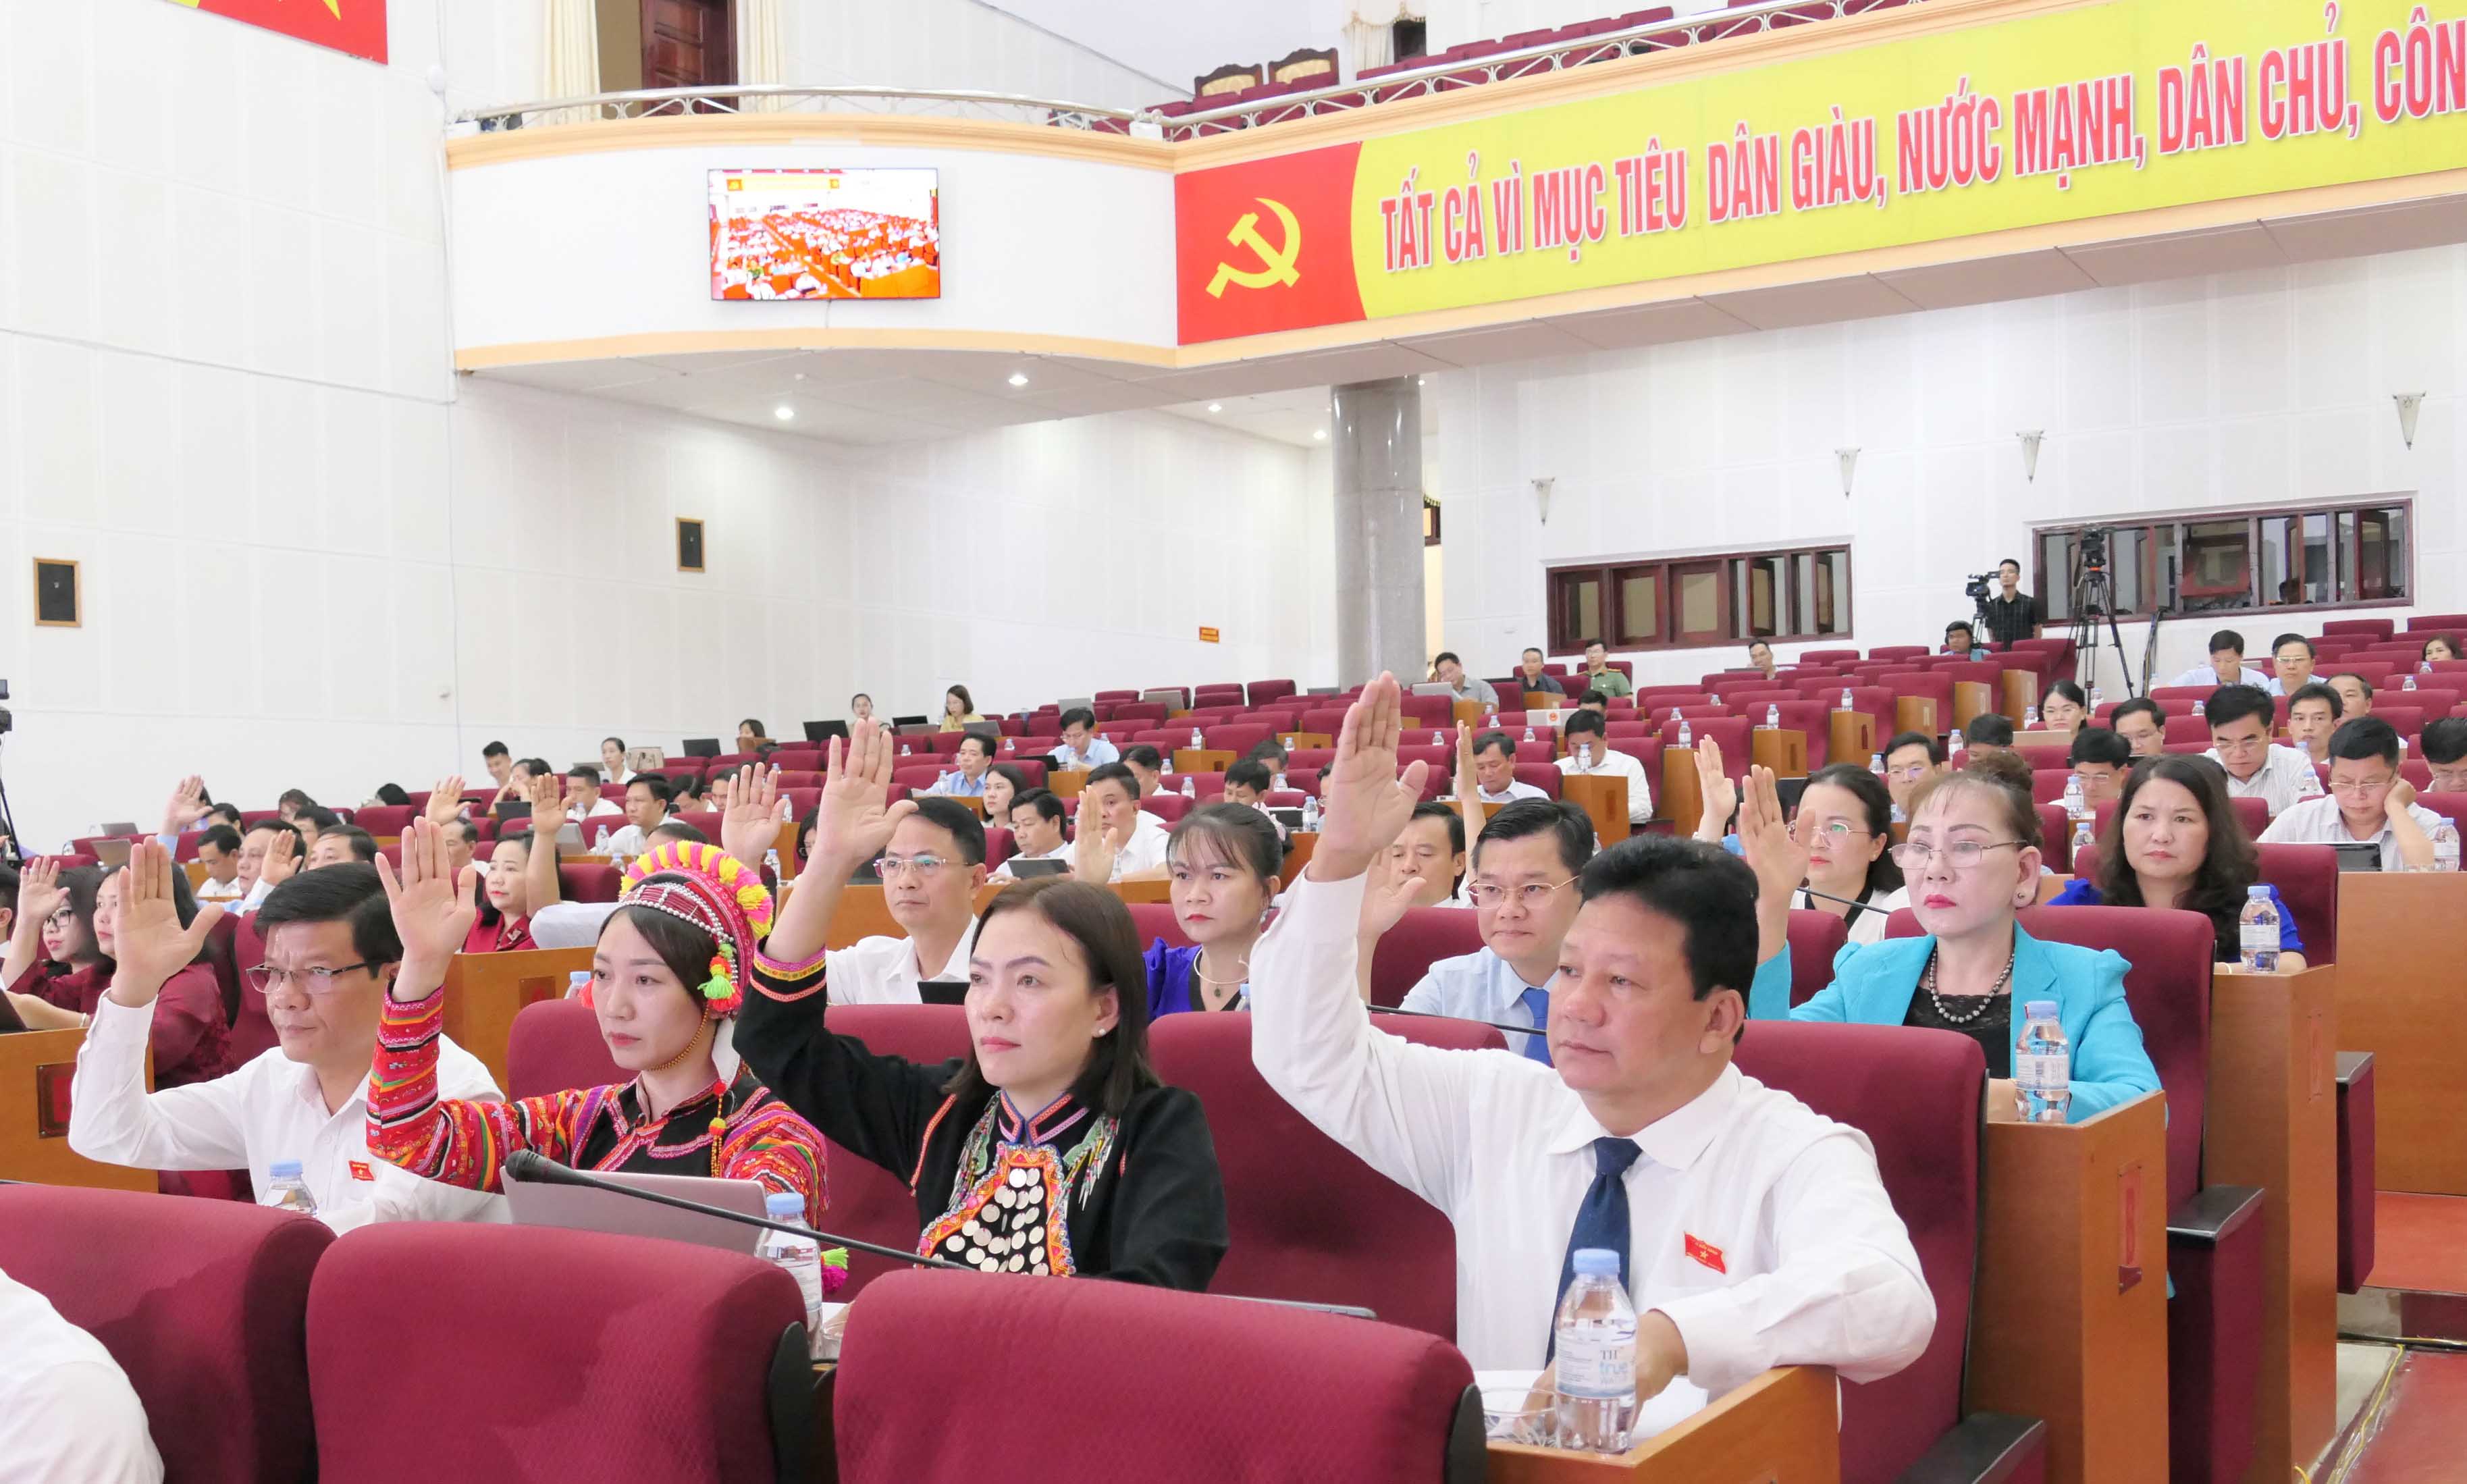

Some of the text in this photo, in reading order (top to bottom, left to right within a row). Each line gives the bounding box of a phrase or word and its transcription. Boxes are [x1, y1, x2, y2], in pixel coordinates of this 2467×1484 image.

[1380, 167, 1435, 271] TẤT
[1443, 151, 1485, 263] CẢ
[1492, 160, 1523, 254] VÌ
[1533, 164, 1606, 261] MỤC
[1614, 137, 1687, 236] TIÊU
[1707, 122, 1780, 222] DÂN
[1790, 106, 1886, 209] GIÀU,
[1896, 76, 2000, 194] NƯỚC
[2013, 74, 2146, 189] MẠNH,
[2158, 43, 2245, 155] DÂN
[2258, 1, 2360, 140] CHỦ,
